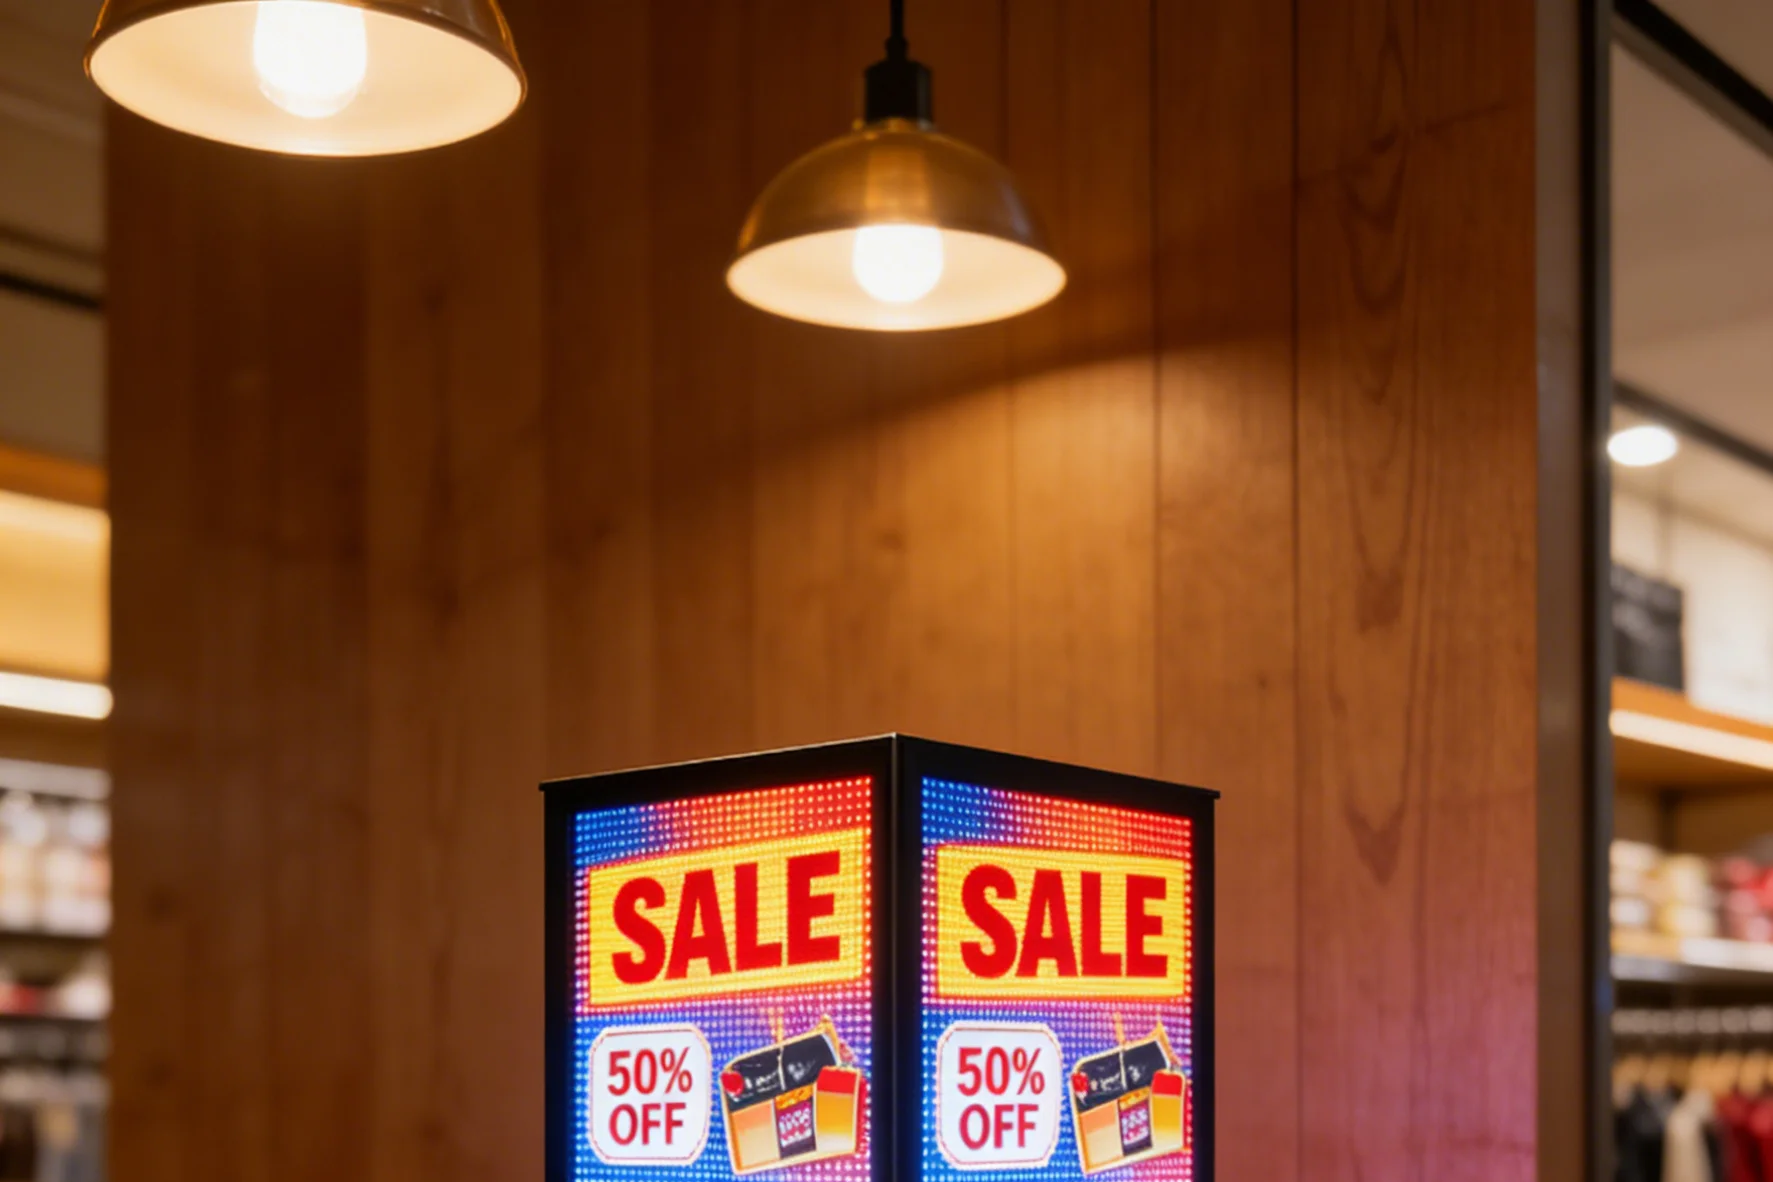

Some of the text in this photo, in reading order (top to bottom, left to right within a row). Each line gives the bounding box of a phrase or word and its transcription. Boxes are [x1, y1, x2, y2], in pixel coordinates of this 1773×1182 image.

[612, 850, 840, 984] SALE
[960, 864, 1168, 979] SALE
[607, 1046, 692, 1097] 50%
[957, 1046, 1045, 1097] 50%
[609, 1102, 687, 1147] OFF
[959, 1103, 1039, 1150] OFF
